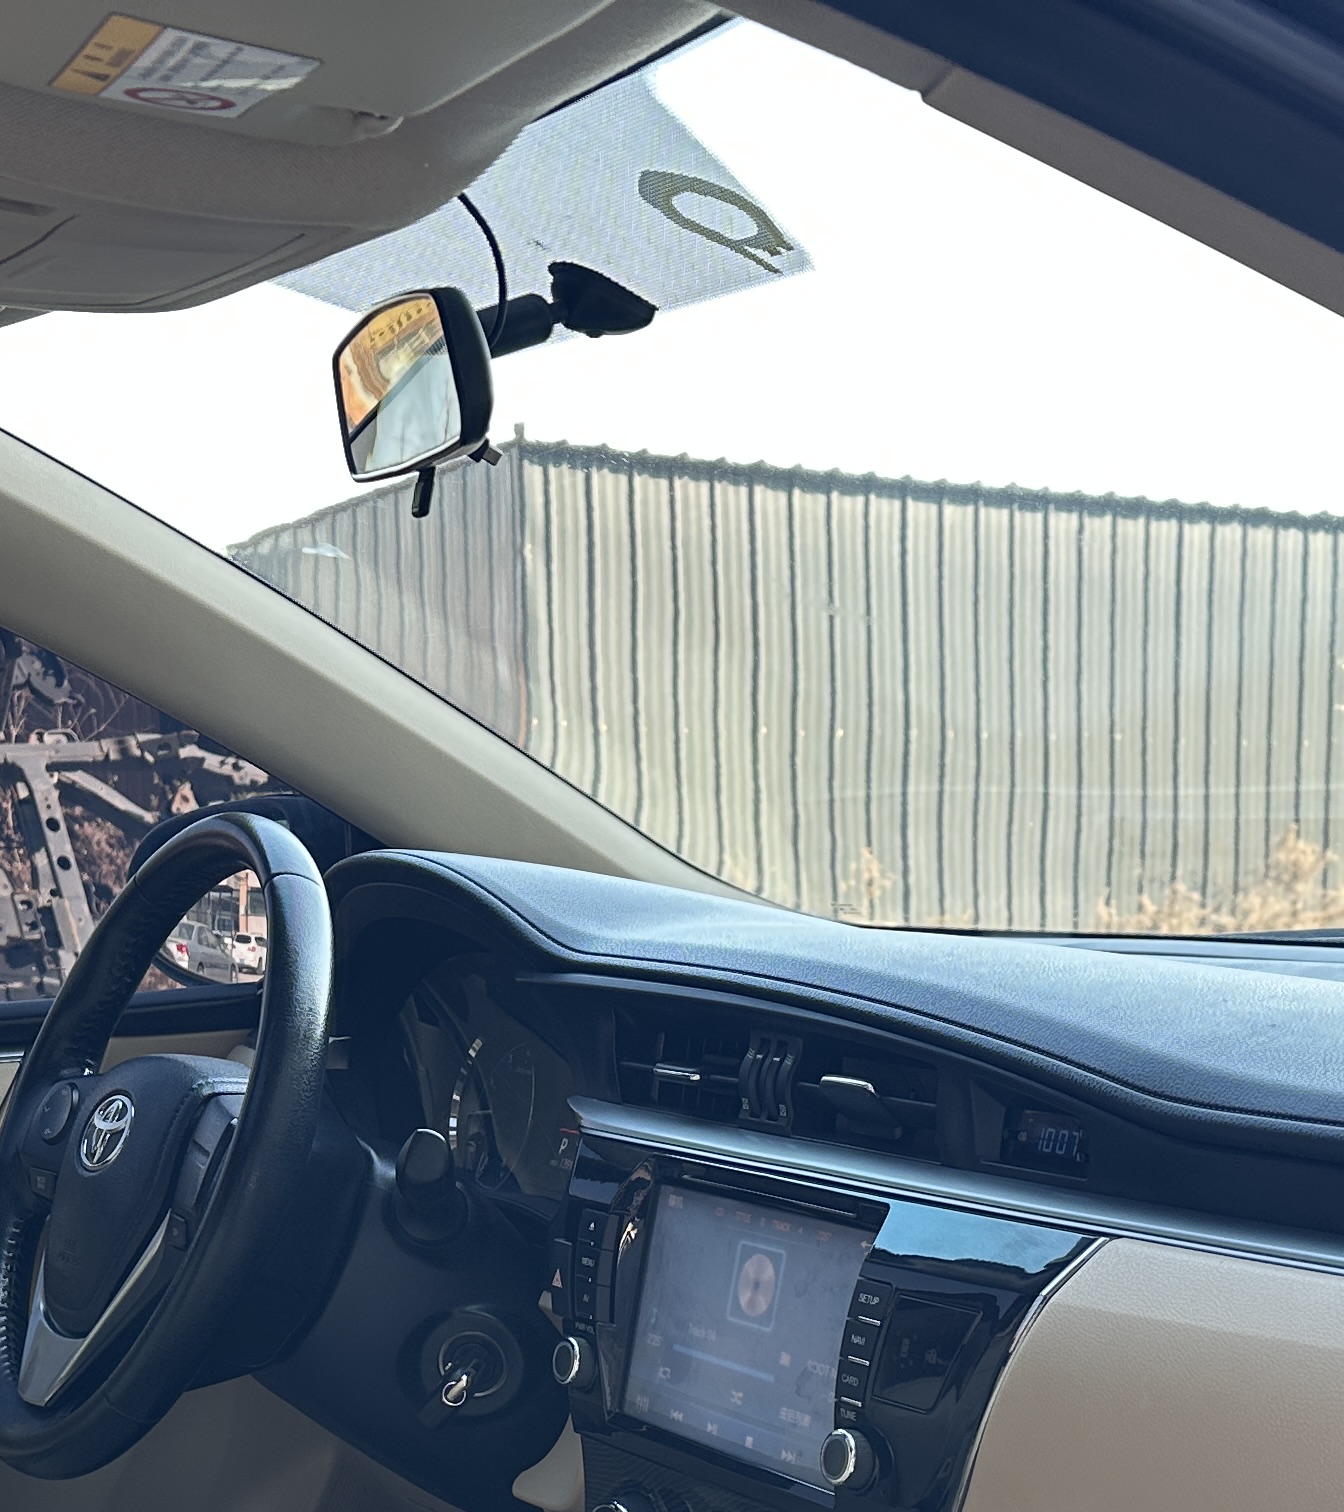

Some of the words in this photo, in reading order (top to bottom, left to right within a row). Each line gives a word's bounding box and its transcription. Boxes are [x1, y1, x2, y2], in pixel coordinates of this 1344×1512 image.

[558, 1137, 568, 1154] P
[858, 1292, 880, 1306] SETUP
[851, 1333, 866, 1346] NAVI
[841, 1373, 859, 1387] CARD
[840, 1408, 857, 1422] TUNE
